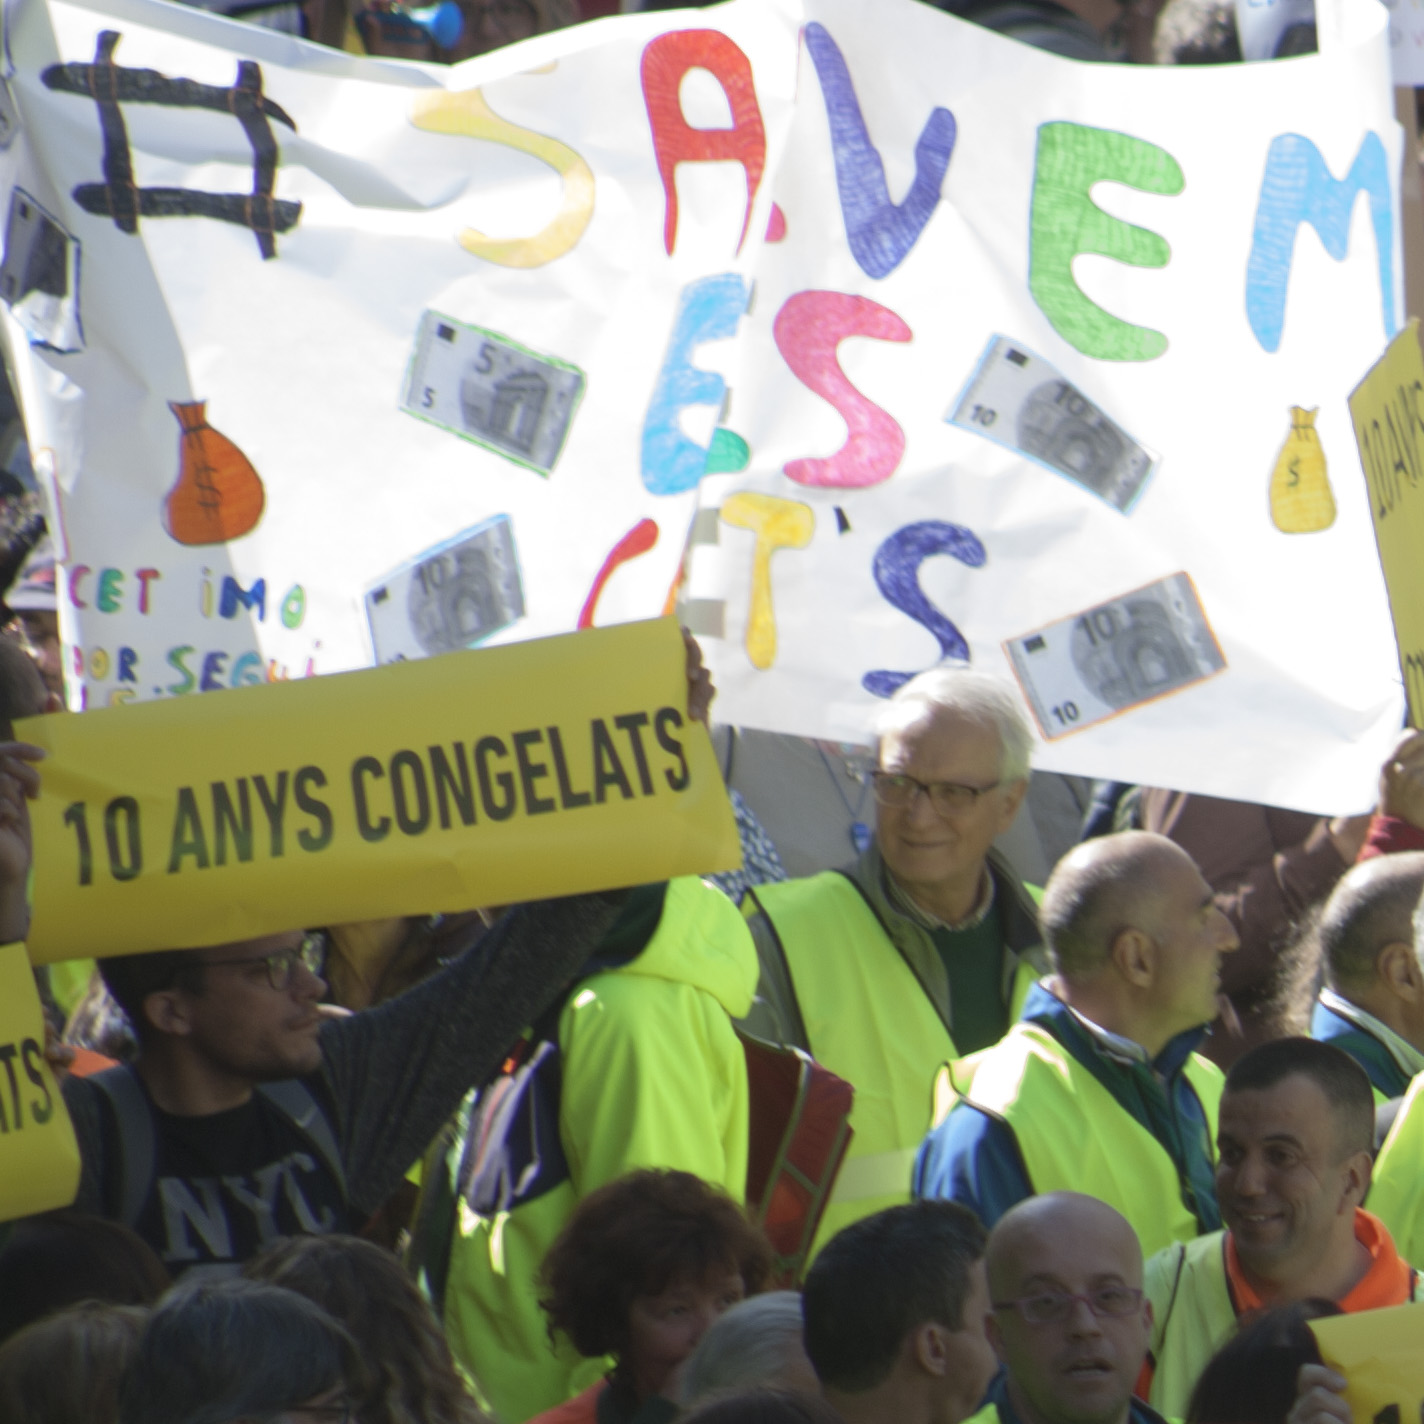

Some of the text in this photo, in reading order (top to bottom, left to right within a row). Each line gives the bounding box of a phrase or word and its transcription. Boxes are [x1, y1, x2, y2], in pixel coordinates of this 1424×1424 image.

[421, 386, 436, 410] 5
[969, 403, 998, 427] 10
[69, 564, 161, 615] CET
[1077, 606, 1118, 648] 10
[1051, 700, 1081, 727] 10
[63, 705, 693, 887] 10 ANYS CONGELATS
[0, 1036, 53, 1136] TS
[159, 1152, 336, 1262] NYC
